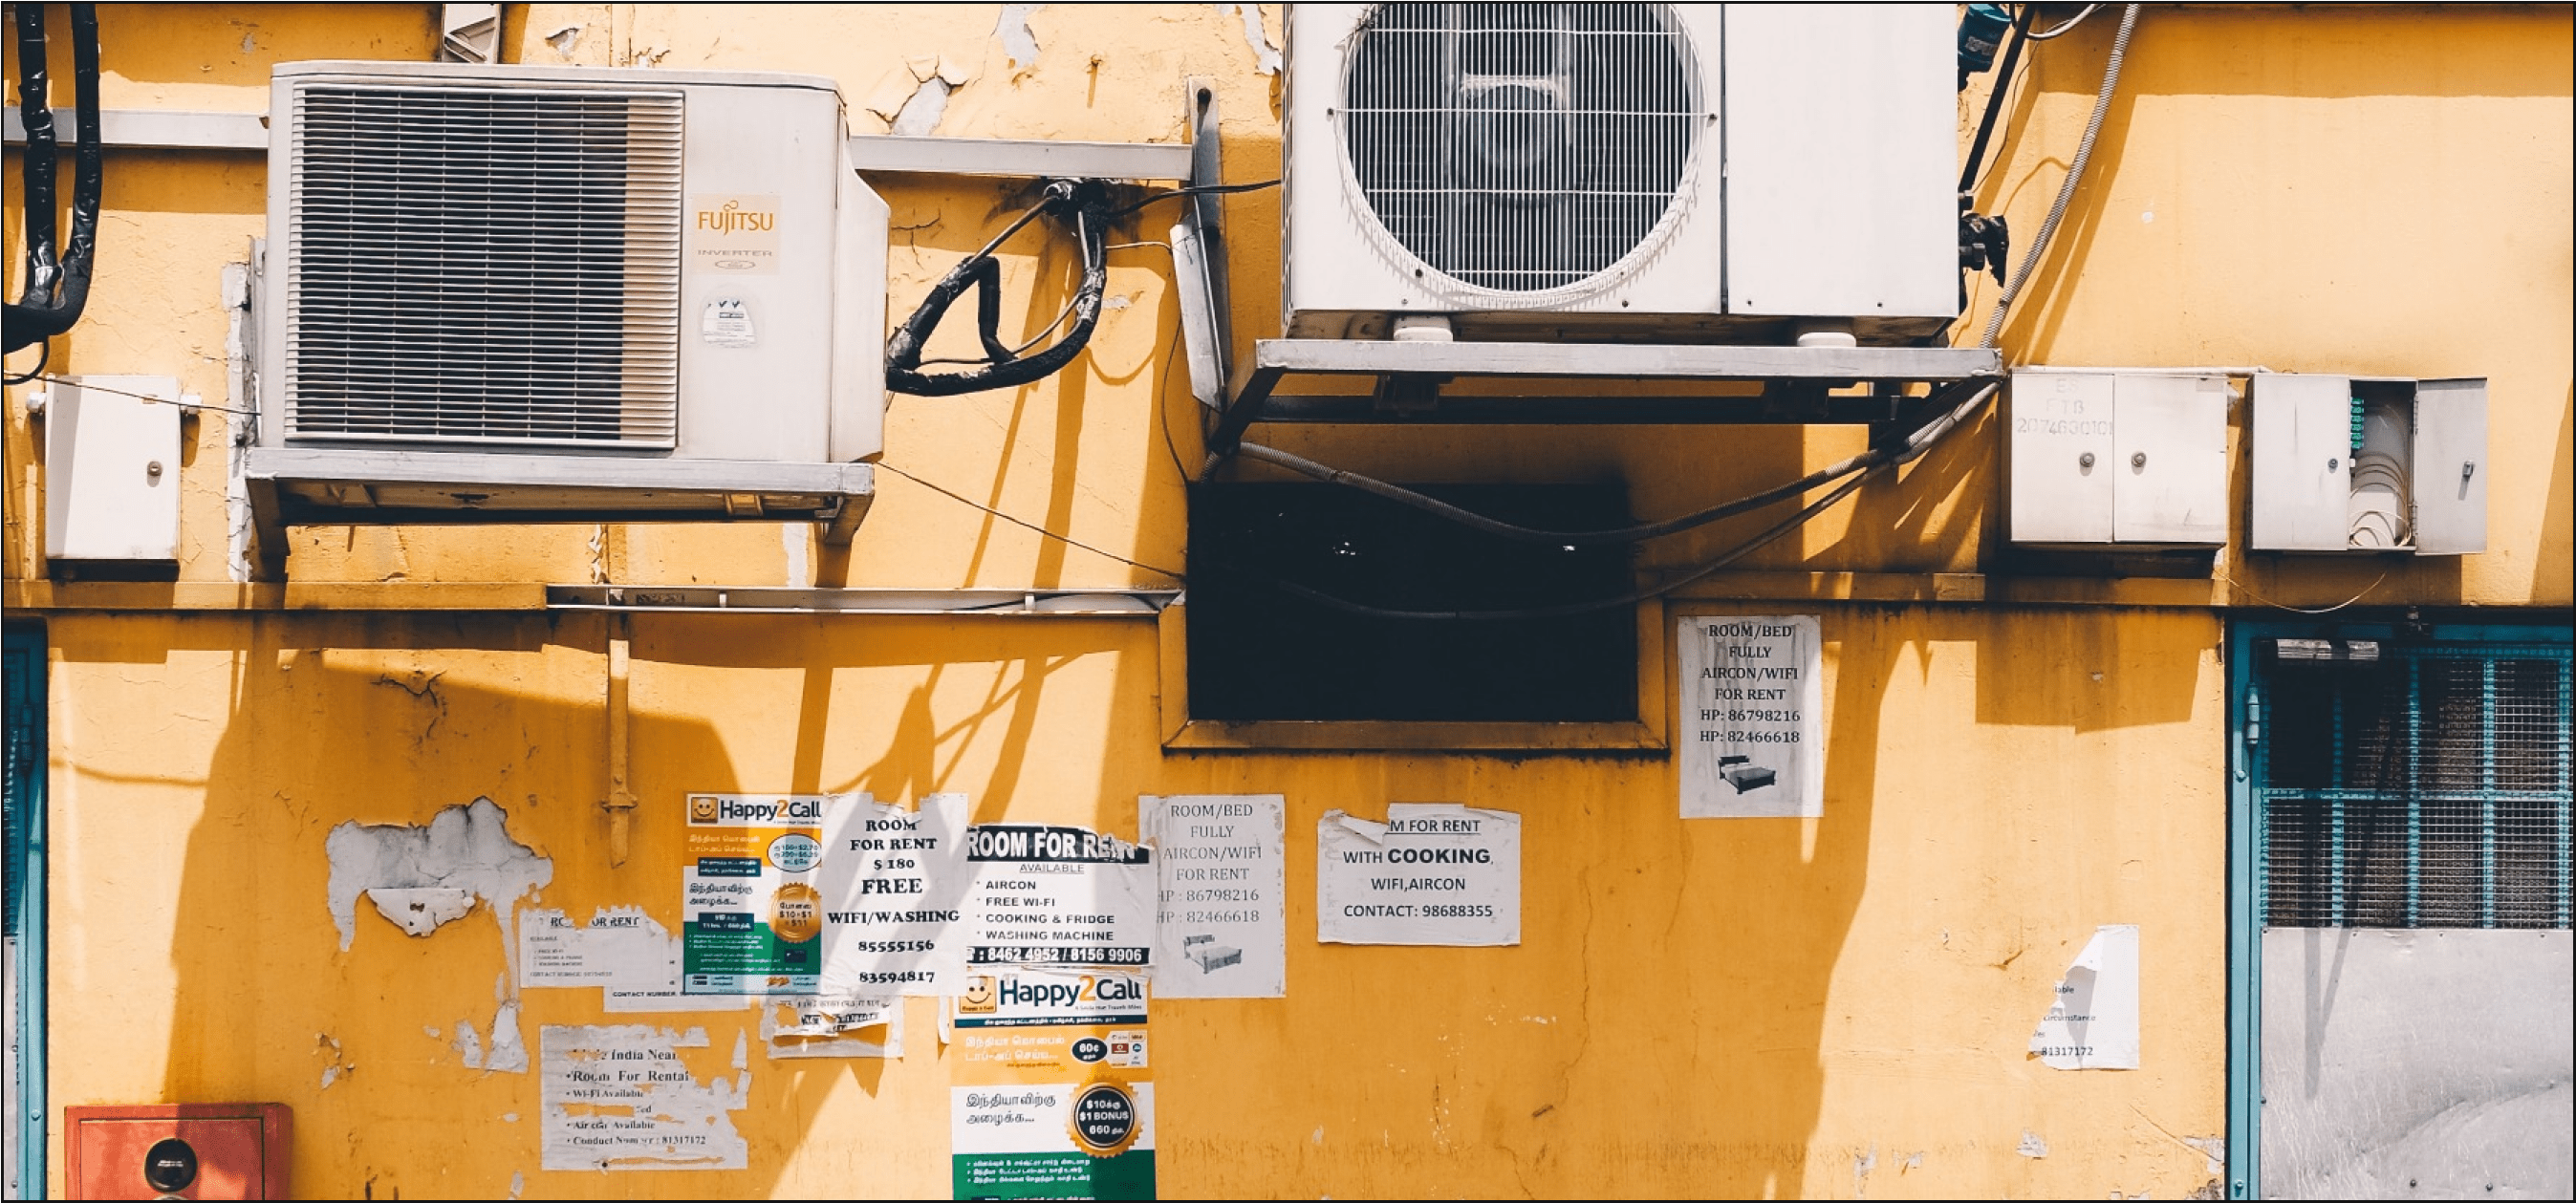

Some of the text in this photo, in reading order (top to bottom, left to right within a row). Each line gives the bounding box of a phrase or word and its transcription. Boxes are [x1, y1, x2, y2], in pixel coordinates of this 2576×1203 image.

[697, 202, 774, 236] FUJITSU
[1708, 624, 1792, 639] ROOM/BED
[1728, 646, 1771, 658] FULLY
[1701, 667, 1798, 682] AIRCON/WIFI
[1715, 689, 1786, 699] FOR RENT
[1699, 709, 1801, 721] HP: 86798216
[1699, 730, 1800, 742] HP: 82466618
[720, 800, 821, 821] Happy2Call
[1170, 805, 1253, 819] ROOM/BED
[865, 819, 918, 832] ROOM
[1409, 820, 1438, 832] FOR
[1442, 820, 1482, 832] RENT
[1190, 826, 1235, 838] FULLY
[850, 838, 938, 850] FOR RENT
[967, 830, 1028, 858] ROOM
[1034, 831, 1077, 858] FOR
[1163, 847, 1262, 862] AIRCON/WIFI
[1343, 849, 1494, 865] WITH COOKING,
[874, 859, 915, 870] $ 180
[1020, 864, 1085, 873] AVAILABLE
[1177, 868, 1250, 880] FOR RENT
[861, 878, 922, 894] FREE
[985, 880, 1036, 890] AIRCON
[1371, 878, 1466, 892] WIFI,AIRCON
[1186, 890, 1260, 901] 86798216
[985, 897, 1055, 907] FREE WI-FI
[1186, 911, 1260, 923] 82466618
[1344, 905, 1493, 917] CONTACT: 98688355
[610, 916, 640, 927] RENT
[828, 910, 961, 926] WIFI/WASHING
[985, 914, 1115, 924] COOKING & FRIDGE
[985, 931, 1115, 941] WASHING MACHINE
[858, 940, 935, 952] 85555156
[987, 947, 1022, 961] 8462
[1071, 948, 1104, 961] 8156
[1108, 948, 1142, 962] 9906
[859, 971, 935, 983] 83594817
[1000, 975, 1142, 1006] Happy2Call
[618, 1070, 640, 1082] For
[1093, 1110, 1129, 1121] BONUS
